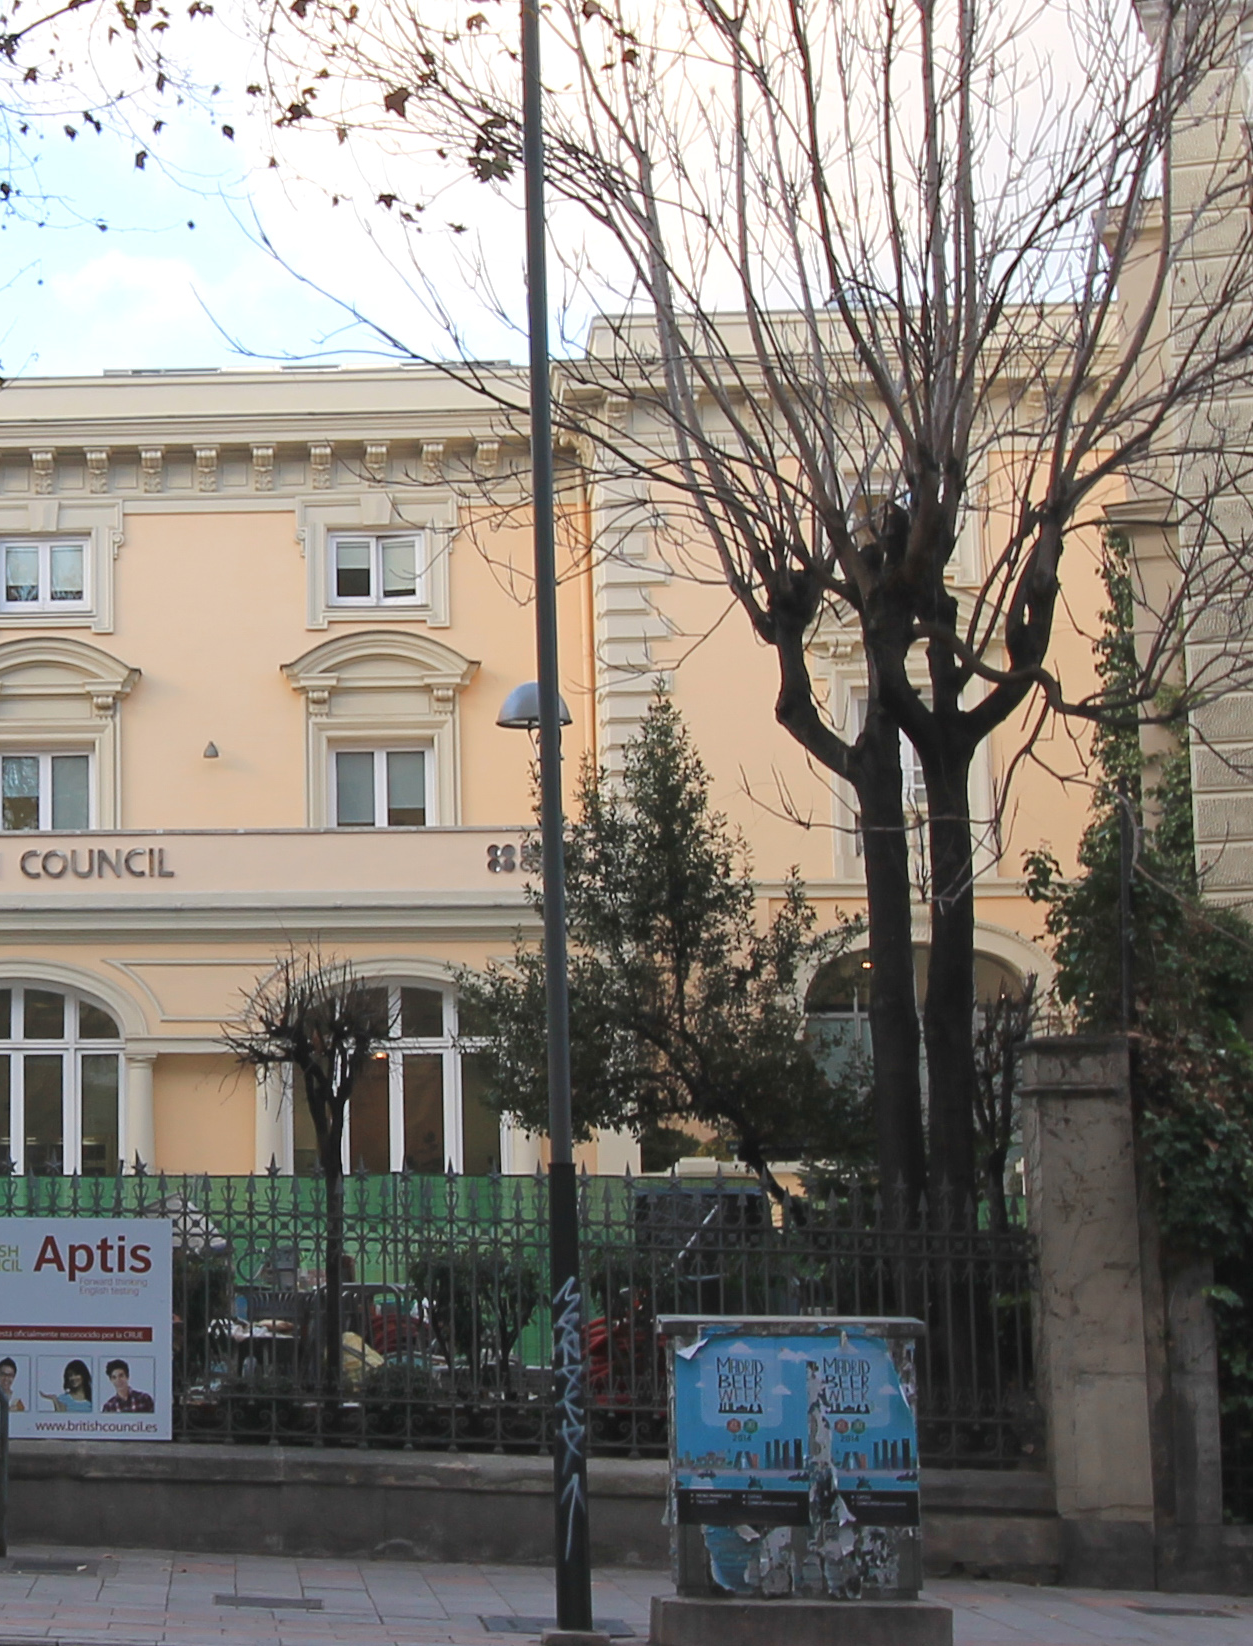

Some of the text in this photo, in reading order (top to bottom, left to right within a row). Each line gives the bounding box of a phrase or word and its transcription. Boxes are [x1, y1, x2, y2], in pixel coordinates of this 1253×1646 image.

[20, 848, 175, 879] COUNCIL
[33, 1235, 153, 1282] Aptis
[716, 1357, 764, 1376] MADRID
[823, 1357, 871, 1376] MADRID
[718, 1374, 763, 1389] BEER
[824, 1375, 869, 1389] BEER
[718, 1388, 762, 1403] WEEK
[827, 1389, 869, 1404] WEEK
[35, 1420, 158, 1433] www.britishcouncil.es
